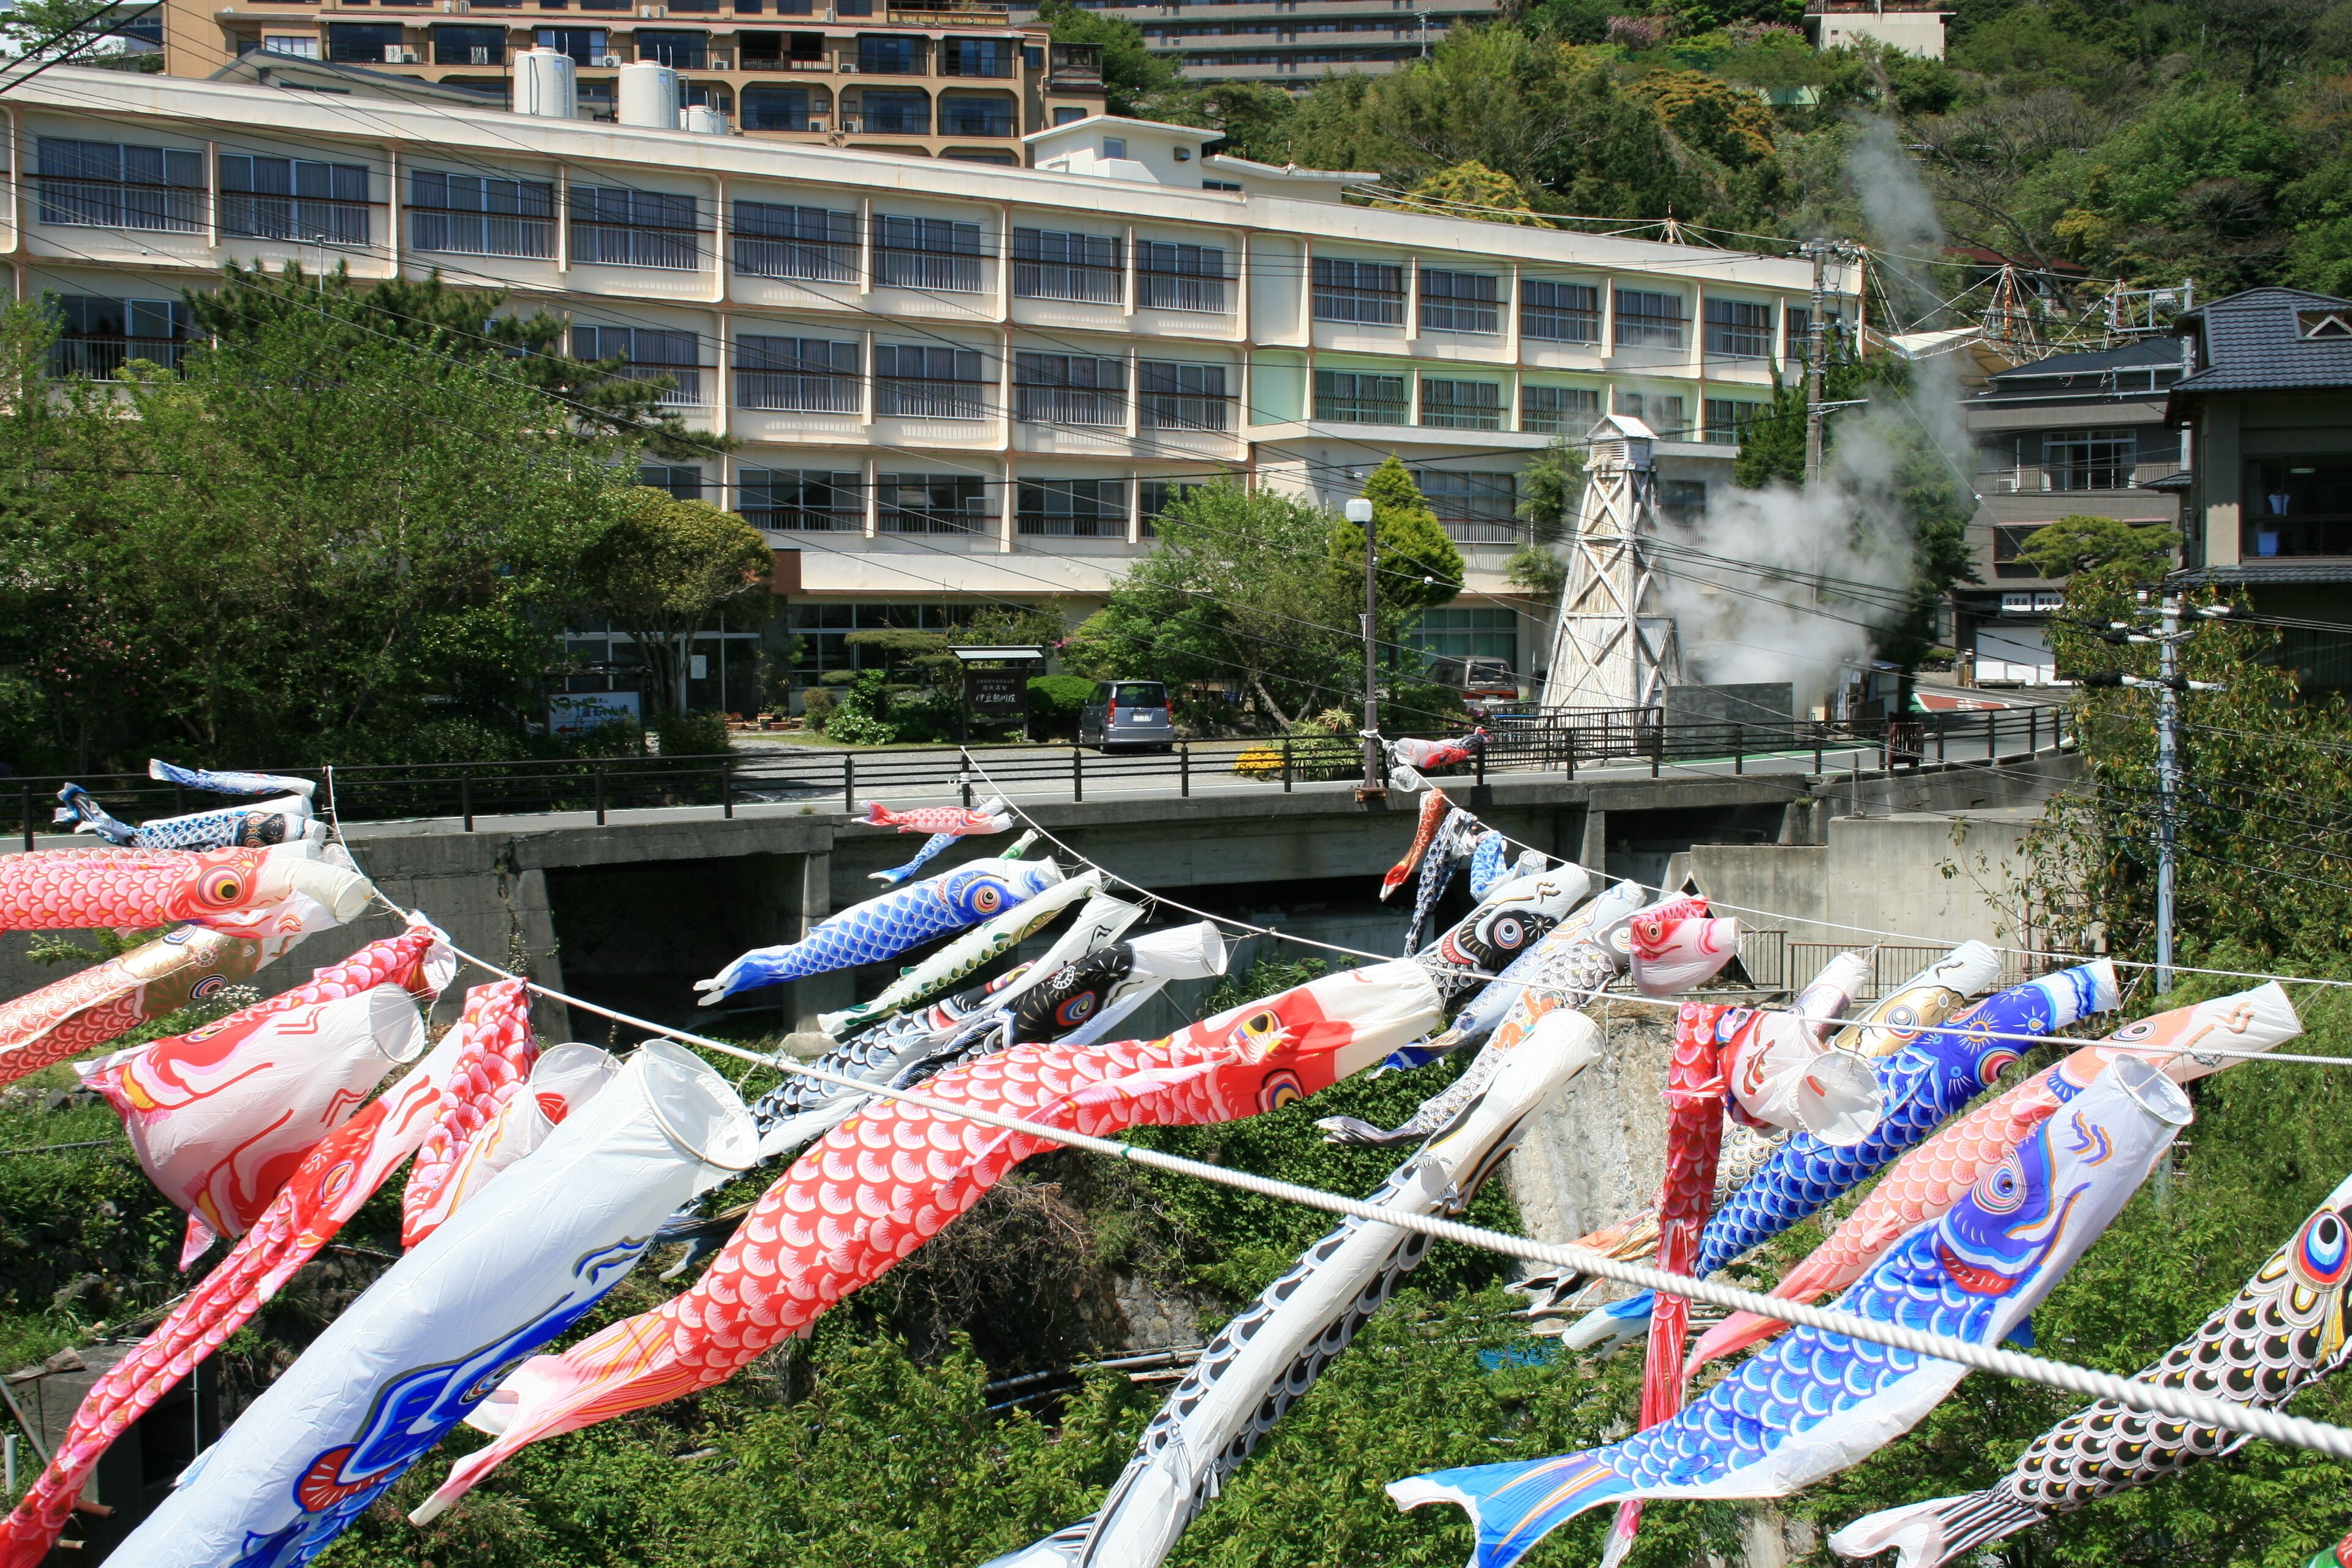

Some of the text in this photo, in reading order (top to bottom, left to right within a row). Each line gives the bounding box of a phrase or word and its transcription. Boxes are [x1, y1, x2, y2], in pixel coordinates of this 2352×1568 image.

[976, 693, 1016, 703] 伊豆熱川荘
